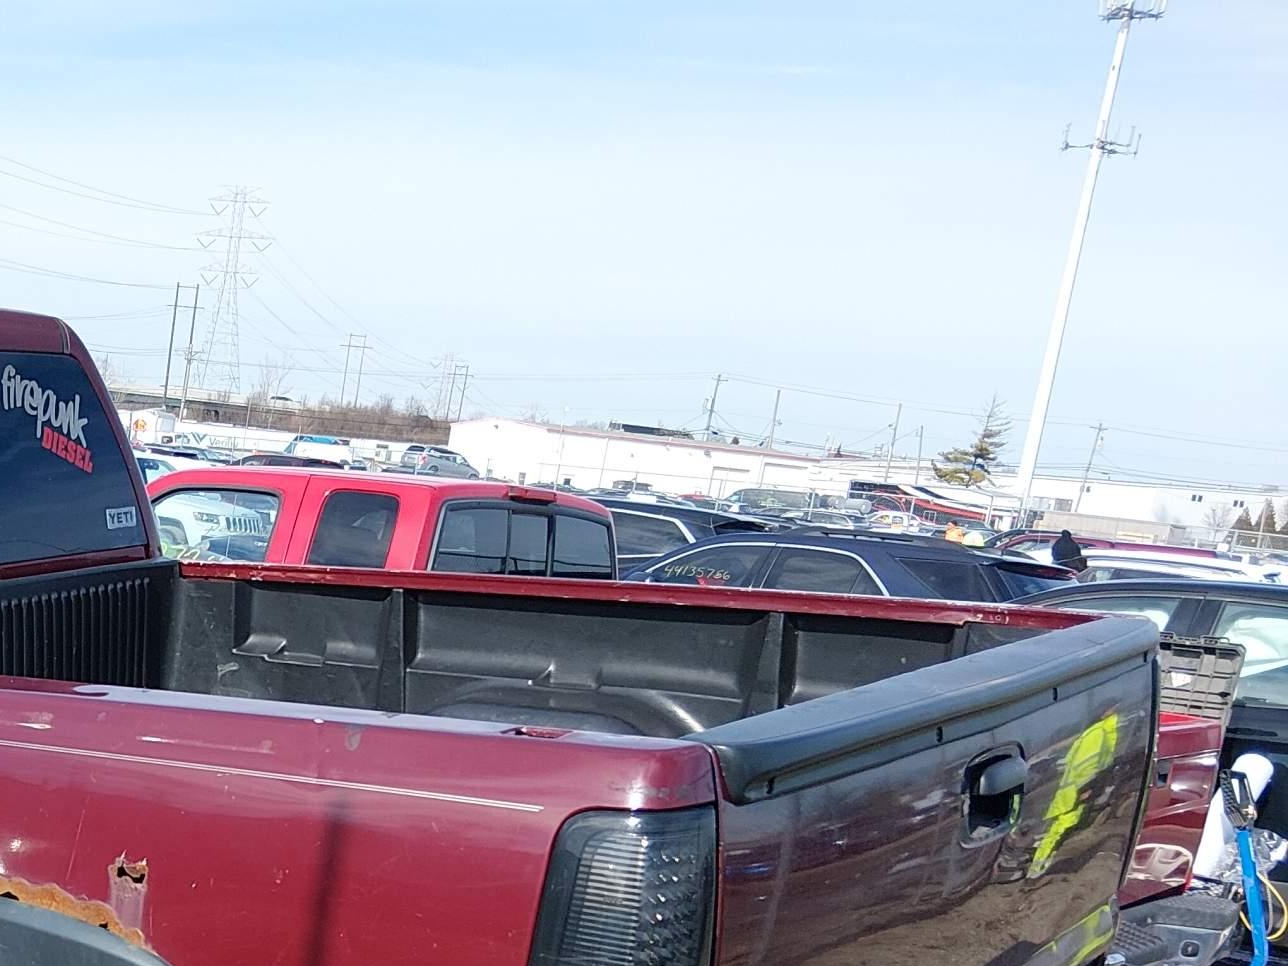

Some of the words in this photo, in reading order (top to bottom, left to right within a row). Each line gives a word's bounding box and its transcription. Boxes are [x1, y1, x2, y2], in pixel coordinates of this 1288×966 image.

[0, 364, 88, 448] firepunk
[41, 426, 94, 474] DIESEL
[109, 510, 135, 525] YETI
